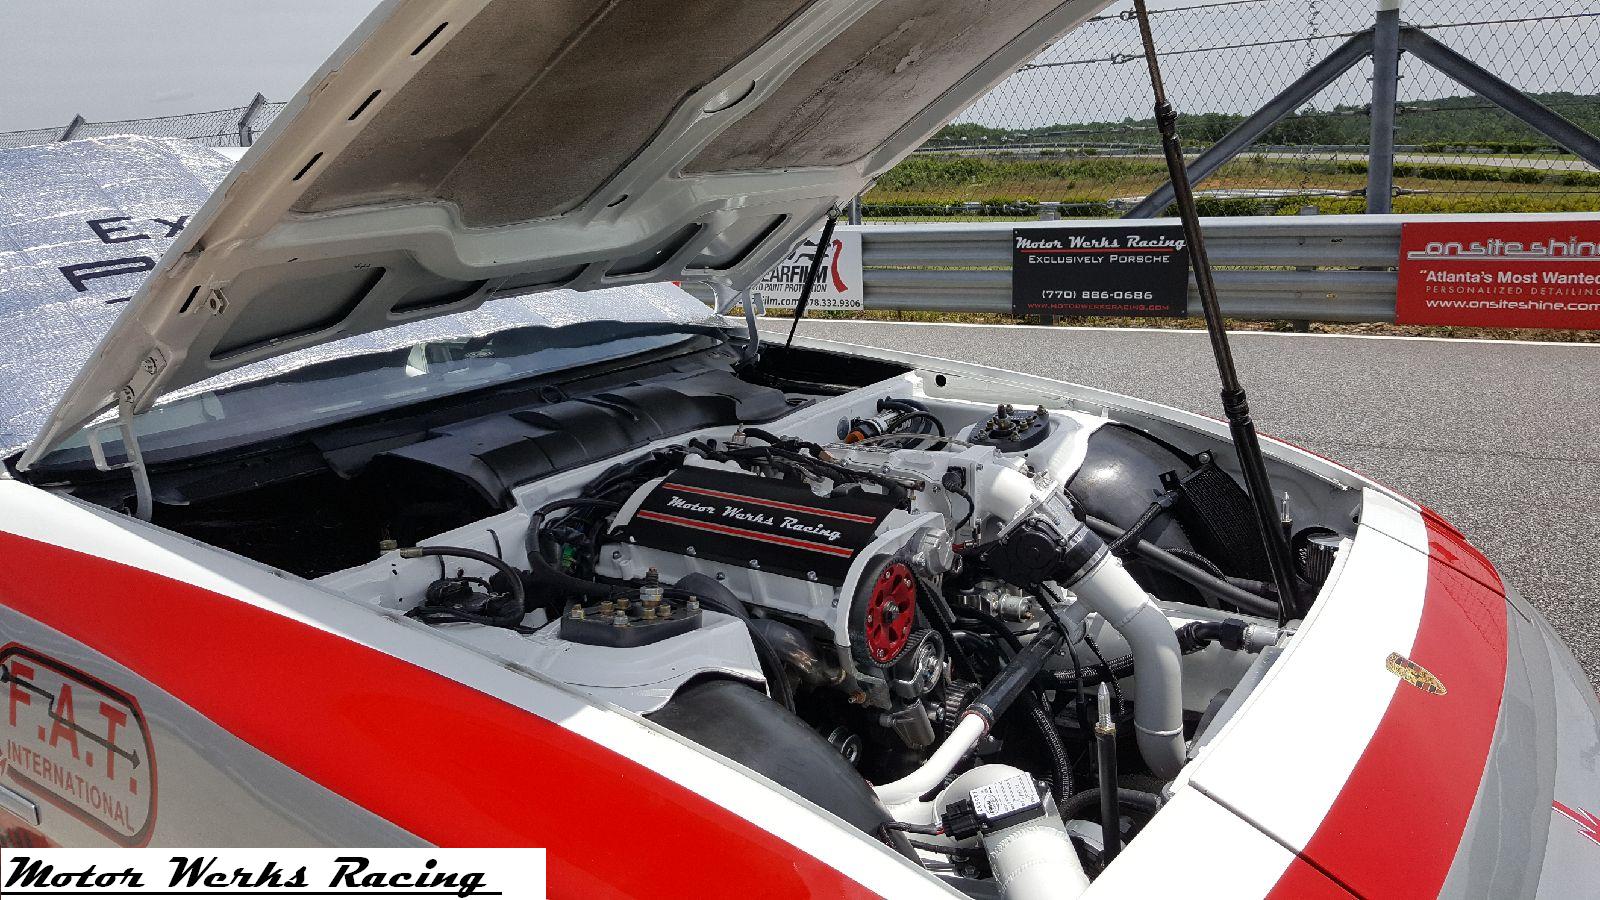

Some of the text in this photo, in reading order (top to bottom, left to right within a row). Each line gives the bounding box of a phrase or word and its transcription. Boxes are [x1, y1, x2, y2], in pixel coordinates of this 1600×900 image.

[1016, 235, 1187, 250] Motor Werks Racing
[1028, 255, 1170, 264] EXCLUSIVELY PORSCHE
[1497, 271, 1538, 284] Most
[1042, 290, 1153, 299] (770) 886-0686
[1426, 286, 1523, 295] PERSONALIZED
[808, 298, 861, 308] 78.332.9306
[667, 496, 843, 541] Motor Werks Racing
[9, 660, 138, 795] F.A.T.
[7, 739, 135, 833] INTERNATIONAL
